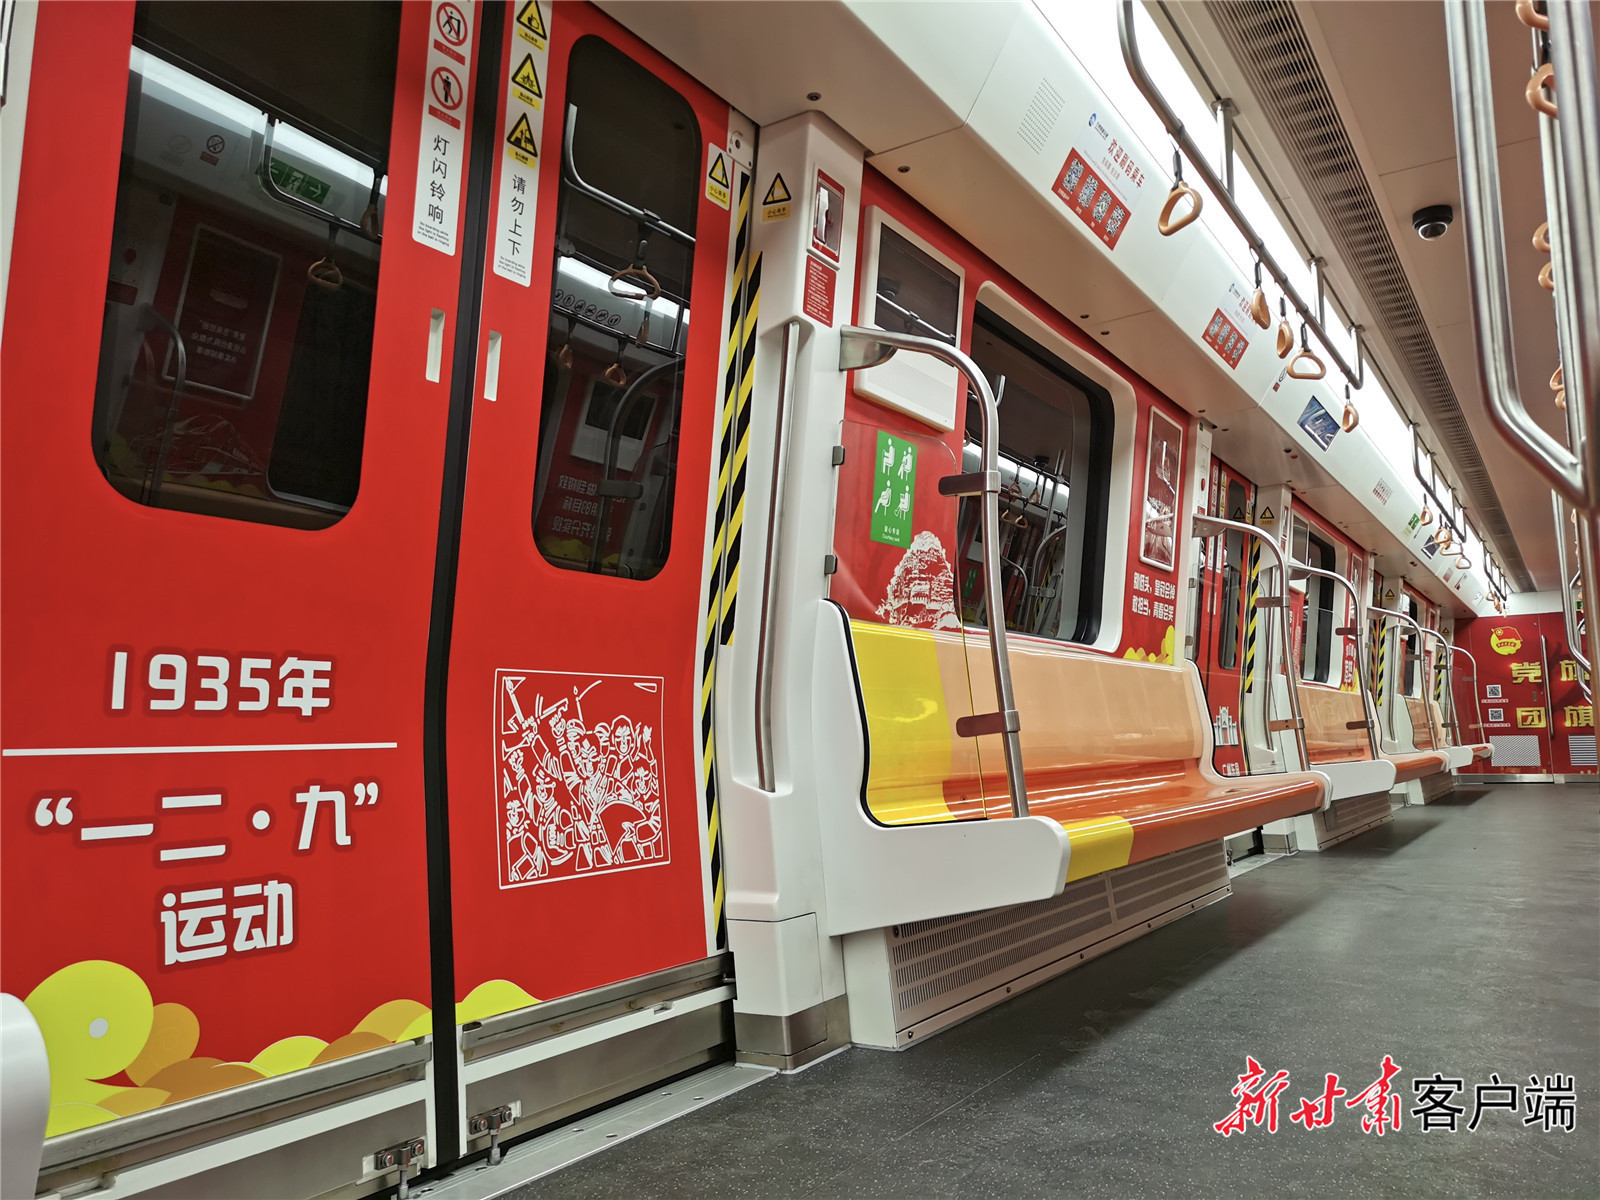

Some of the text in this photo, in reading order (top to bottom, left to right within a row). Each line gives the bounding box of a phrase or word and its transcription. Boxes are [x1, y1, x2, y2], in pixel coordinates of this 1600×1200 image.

[428, 134, 450, 224] 灯闪铃响
[508, 174, 526, 256] 请勿上下
[111, 651, 333, 716] 1935年
[161, 880, 294, 965] 运动
